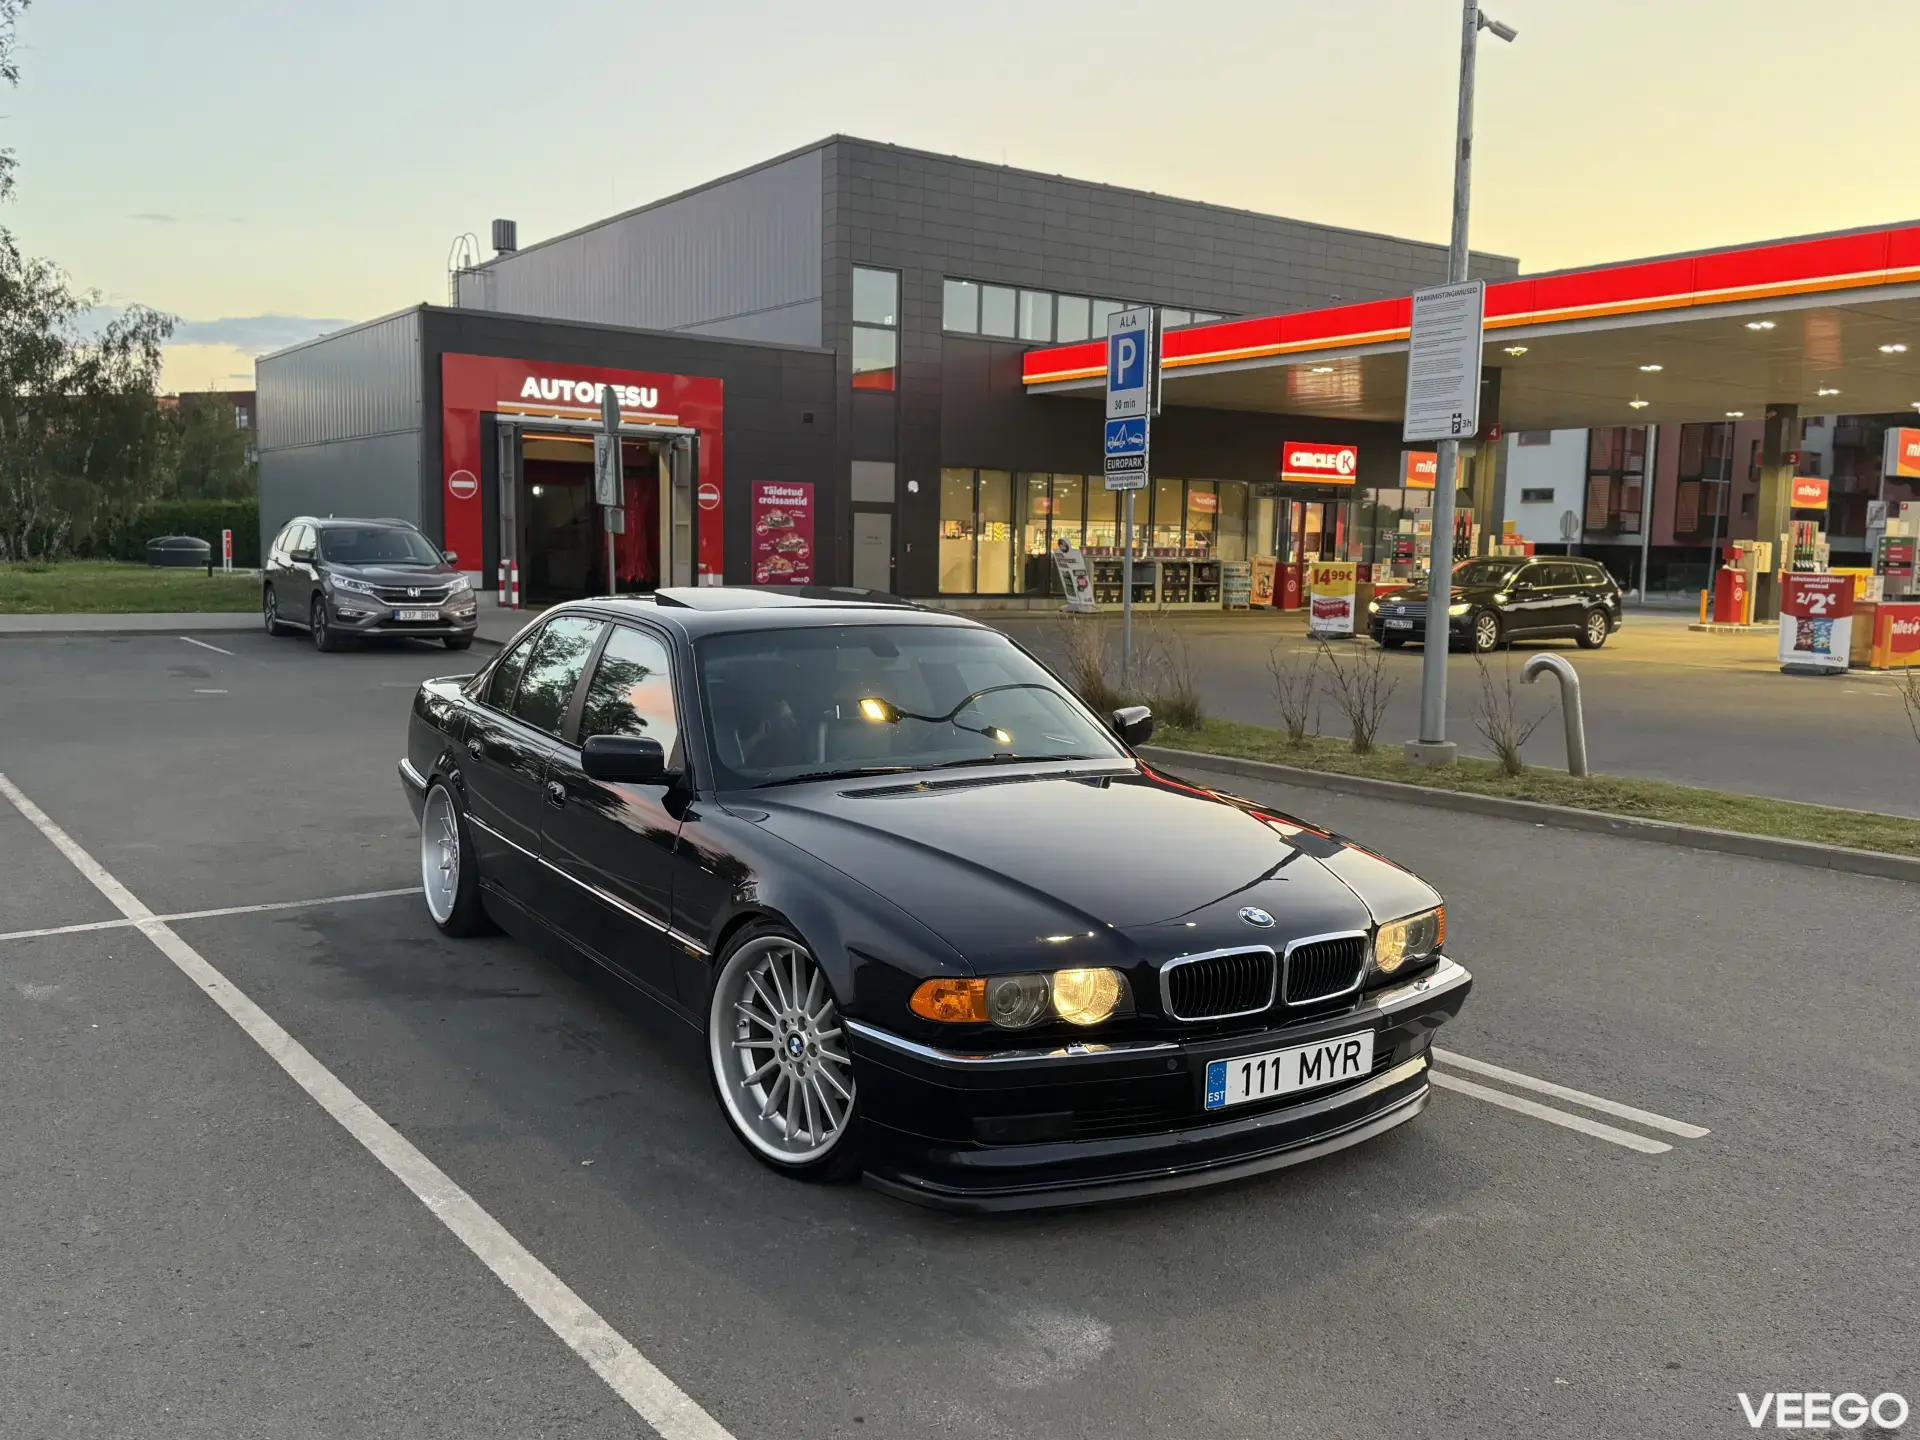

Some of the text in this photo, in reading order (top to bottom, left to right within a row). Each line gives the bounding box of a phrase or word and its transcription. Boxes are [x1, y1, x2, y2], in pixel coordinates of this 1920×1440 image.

[1416, 286, 1478, 302] PARKIMISTINGIMUSED
[1119, 314, 1137, 329] ALA
[1117, 337, 1137, 385] P
[1114, 397, 1136, 410] 30 min
[1462, 418, 1472, 428] 3h
[1490, 427, 1497, 437] 4
[1906, 440, 1920, 457] mi
[1107, 456, 1143, 470] EUROPARK
[1340, 453, 1354, 472] K
[1789, 454, 1796, 462] 2
[1415, 459, 1437, 474] mile
[763, 485, 804, 496] Täidetud
[758, 496, 808, 506] croissantid
[402, 611, 437, 619] 337 BRK
[1241, 1040, 1361, 1097] 111 MYR
[1208, 1090, 1225, 1102] EST
